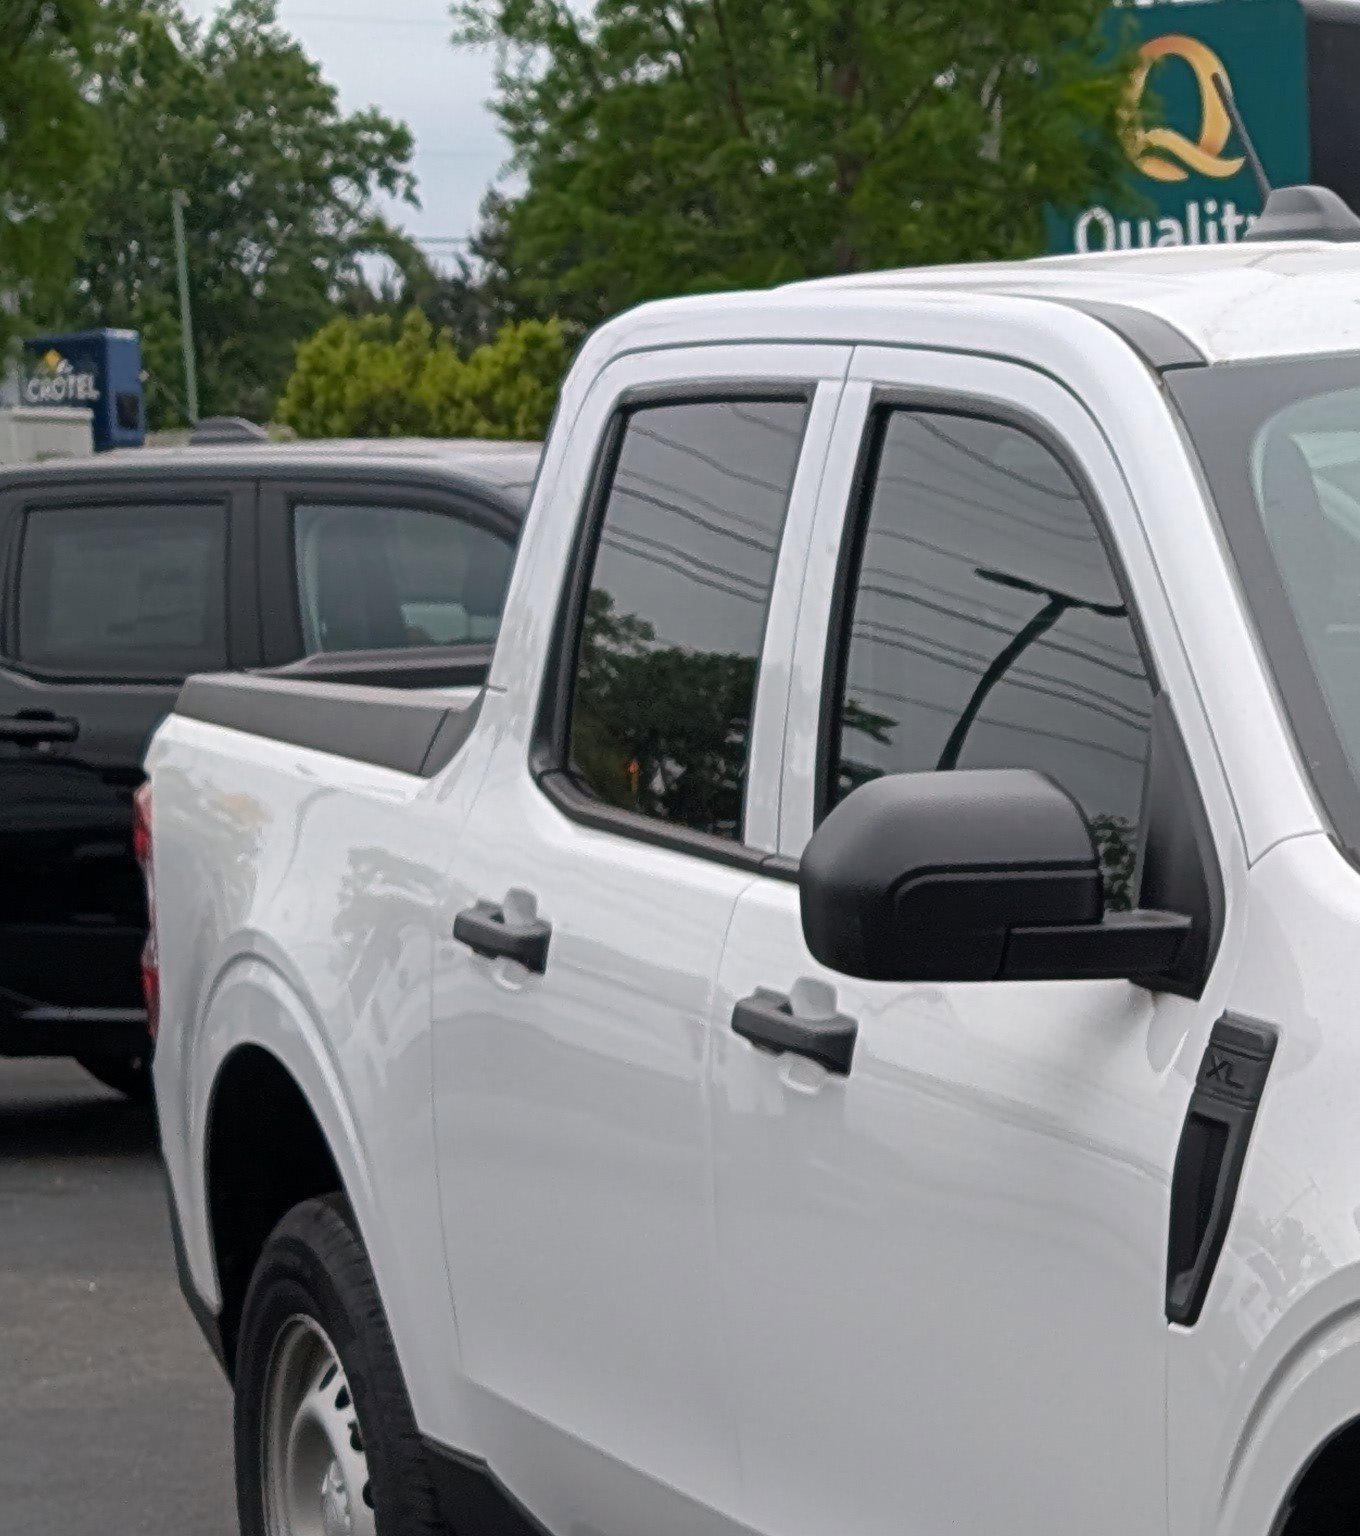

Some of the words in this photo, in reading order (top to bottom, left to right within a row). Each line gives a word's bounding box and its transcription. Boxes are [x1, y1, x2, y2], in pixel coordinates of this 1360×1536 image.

[1117, 34, 1246, 182] Q
[1073, 198, 1257, 254] Qualit
[1206, 1055, 1245, 1089] XL
